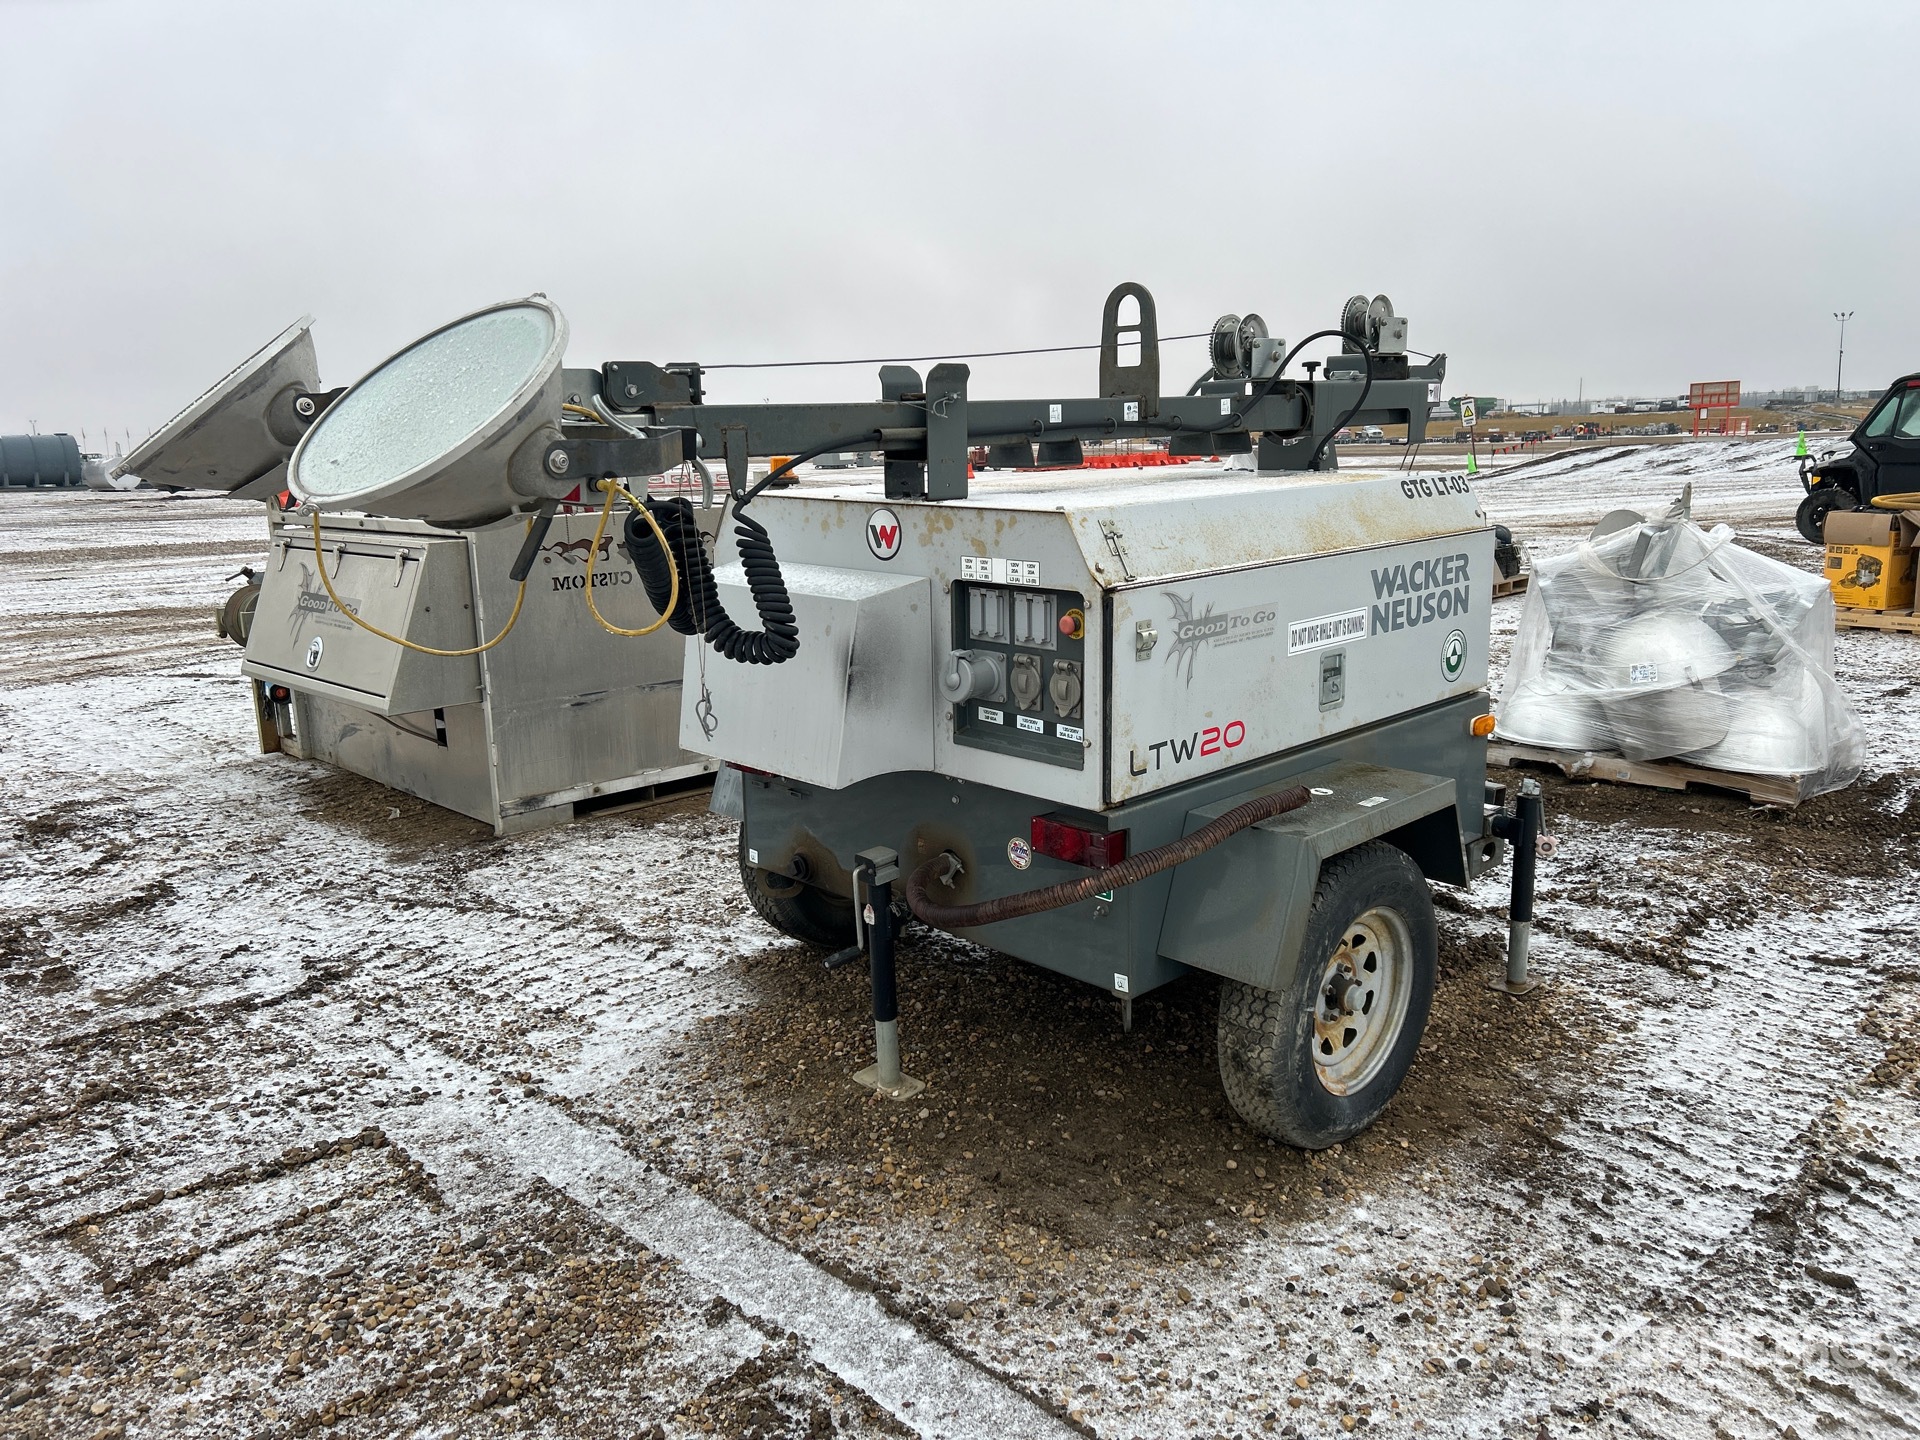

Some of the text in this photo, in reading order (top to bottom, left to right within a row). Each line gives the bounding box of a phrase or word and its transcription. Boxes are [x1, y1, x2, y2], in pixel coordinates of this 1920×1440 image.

[1401, 475, 1470, 499] GTG LT-03
[1370, 553, 1471, 600] WACKER
[1291, 629, 1297, 648] DO
[1298, 627, 1307, 646] NOT
[1307, 625, 1319, 644] MOVE
[1320, 622, 1332, 641] WHILE
[1332, 620, 1342, 638] UNIT
[1342, 618, 1347, 636] IS
[1347, 615, 1365, 635] RUNNING
[1371, 584, 1470, 636] NEUSON
[1129, 720, 1246, 777] LTW20
